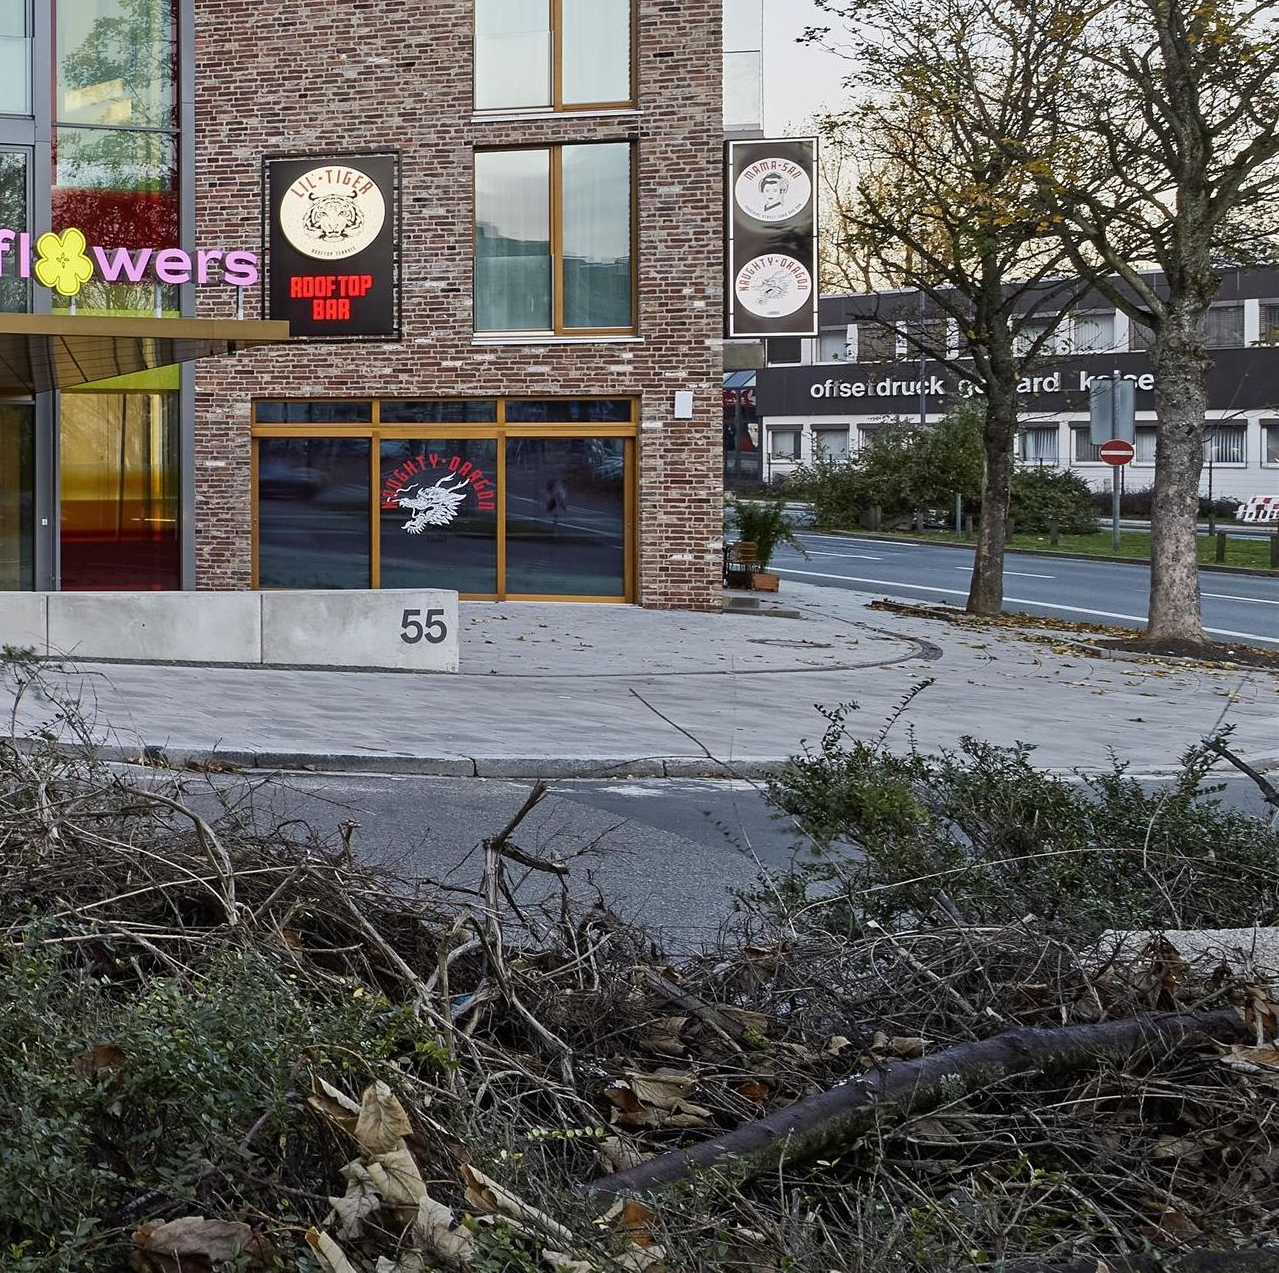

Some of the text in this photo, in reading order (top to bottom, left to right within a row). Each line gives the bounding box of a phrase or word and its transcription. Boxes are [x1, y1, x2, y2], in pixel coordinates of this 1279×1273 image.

[326, 169, 373, 195] TIGER
[744, 161, 803, 181] MAMA SAN
[290, 275, 373, 298] ROOFTOP
[739, 257, 808, 292] NAUGHTY DRAGON
[312, 299, 351, 320] BAR
[380, 453, 495, 510] NAUGHTY DRAGON
[400, 609, 448, 644] 55
